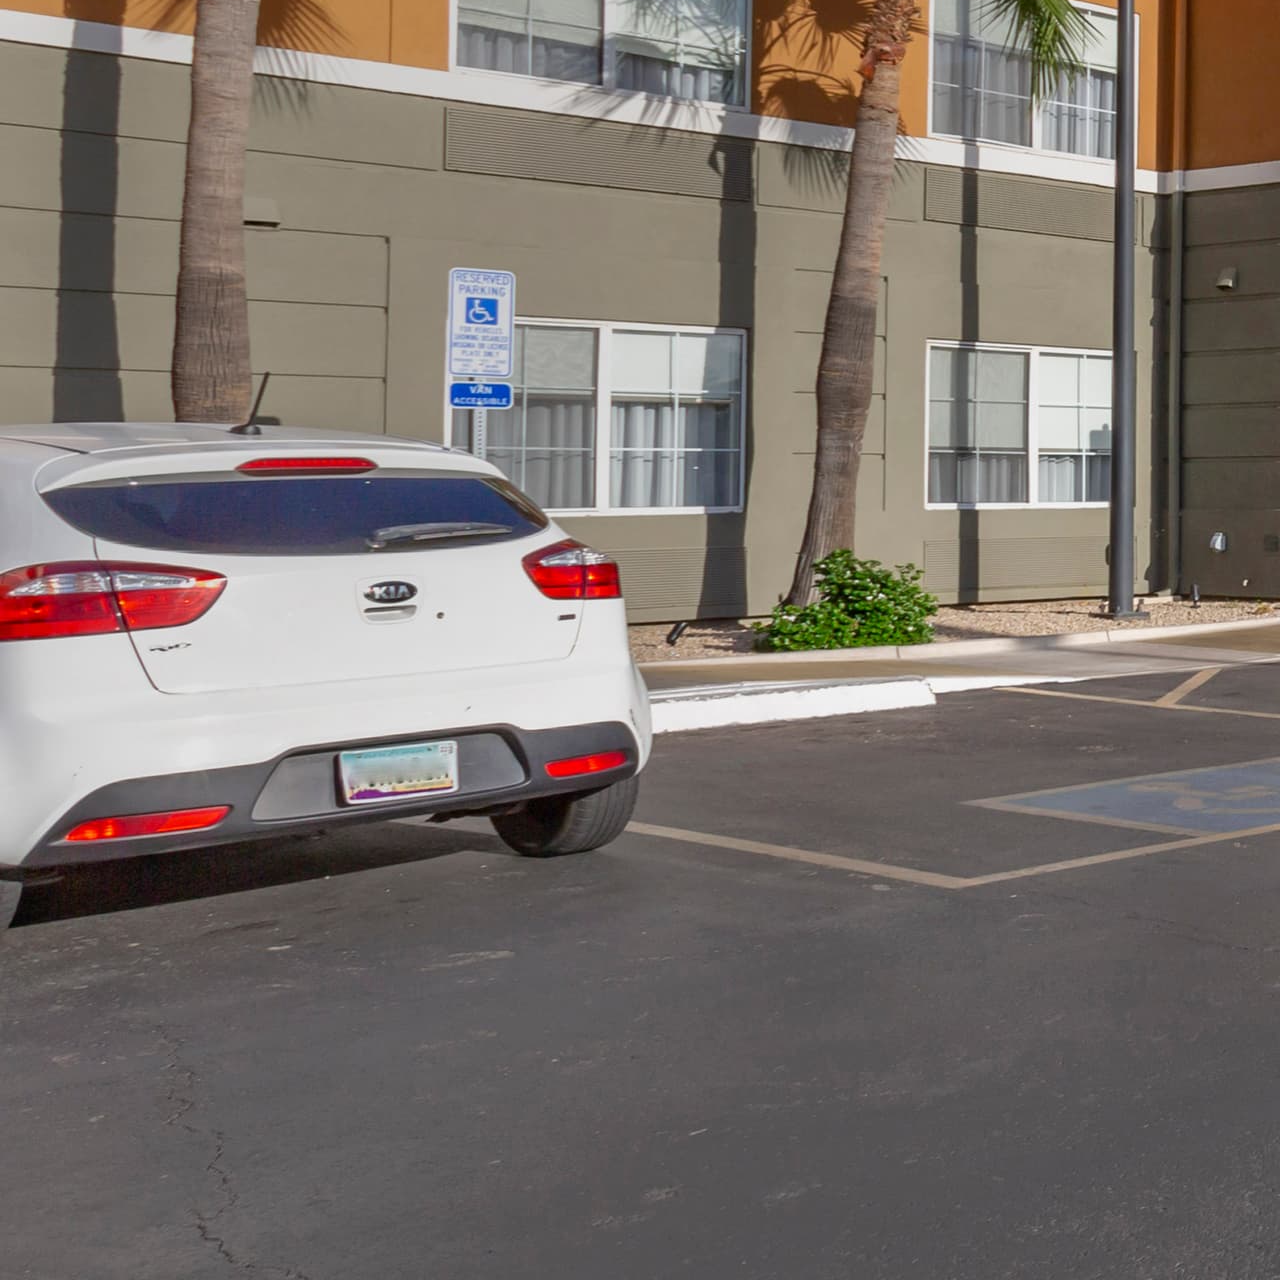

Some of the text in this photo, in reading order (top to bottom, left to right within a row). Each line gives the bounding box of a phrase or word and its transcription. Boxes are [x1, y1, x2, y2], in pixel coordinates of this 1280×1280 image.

[456, 272, 509, 286] RESERVED
[459, 284, 506, 297] PARKING
[469, 385, 493, 395] VAN
[453, 397, 508, 405] ACCESSIBLE
[373, 585, 411, 599] KIA
